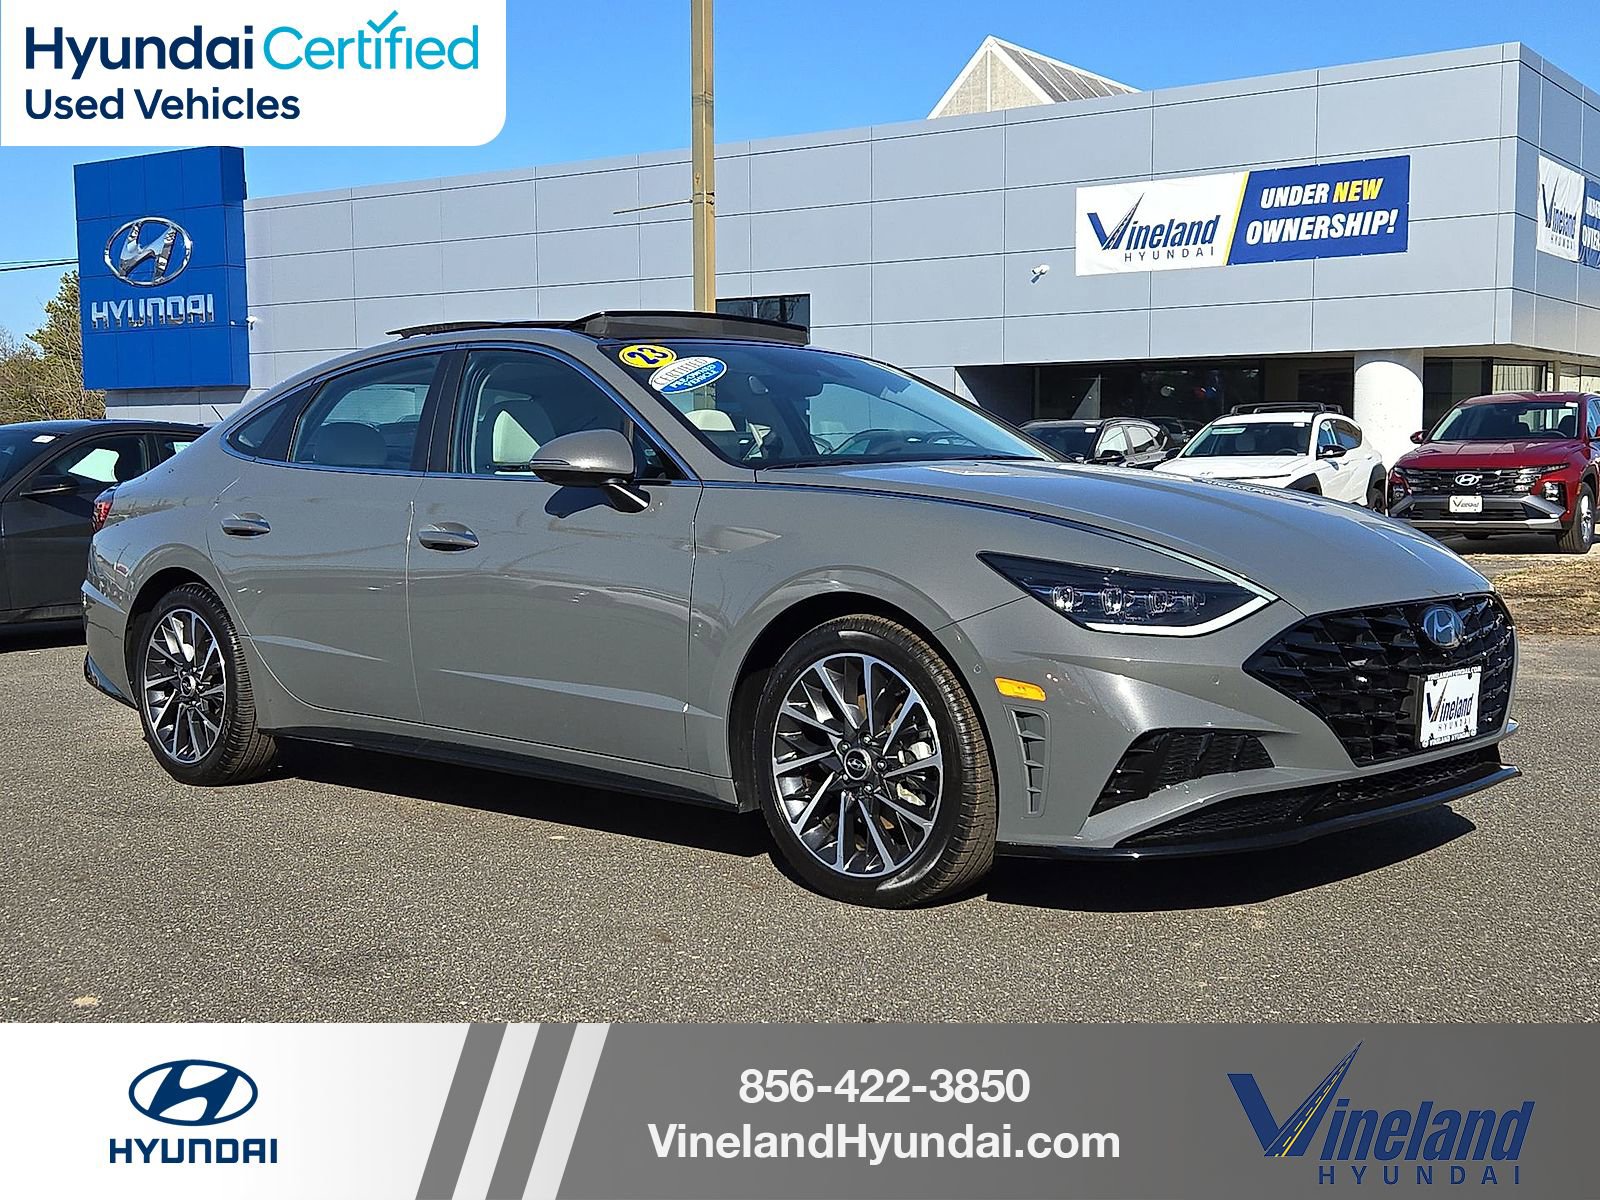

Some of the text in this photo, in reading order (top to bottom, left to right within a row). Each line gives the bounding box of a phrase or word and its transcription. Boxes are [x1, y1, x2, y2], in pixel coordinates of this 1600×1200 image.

[1260, 178, 1384, 209] UNDER NEW
[1087, 192, 1221, 251] Vineland
[1245, 209, 1399, 246] OWNERSHIP!
[1124, 246, 1215, 262] HYUNDAI
[91, 293, 215, 329] HYUNDAI
[627, 347, 668, 365] 23
[1426, 679, 1474, 723] Vineland
